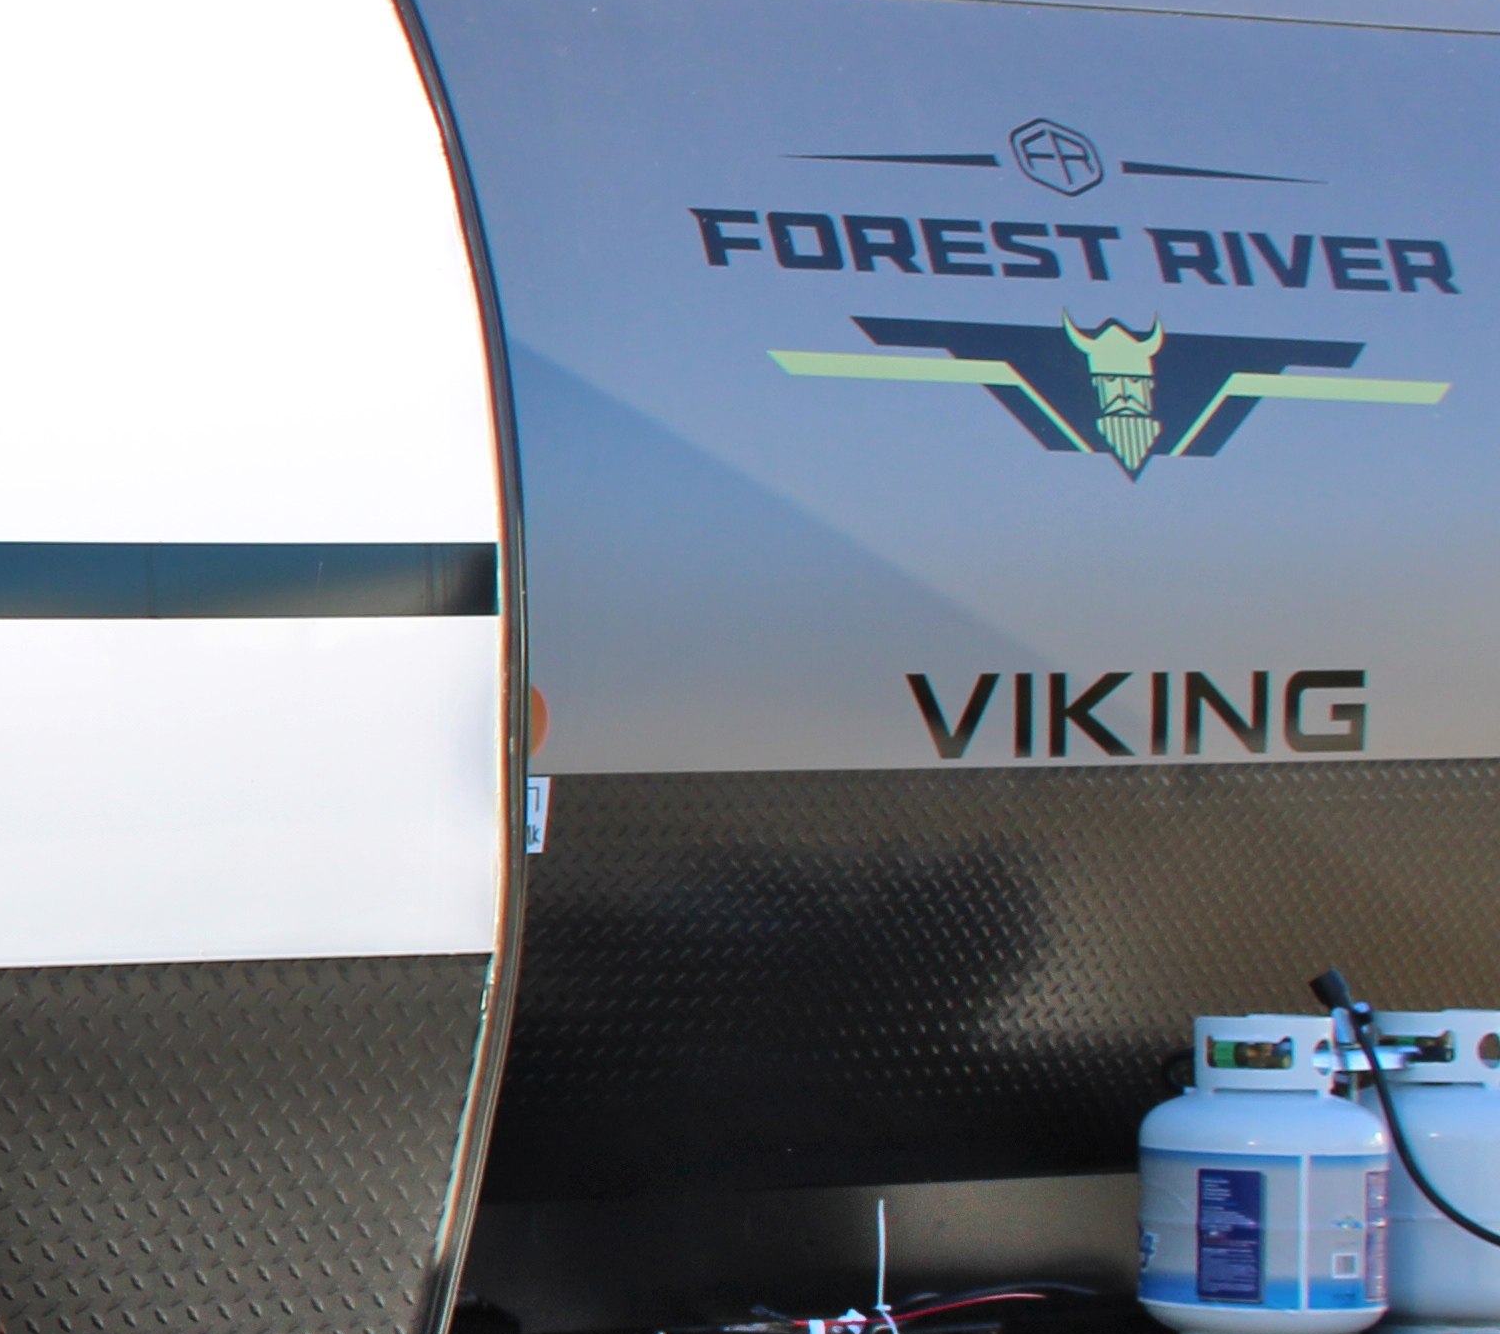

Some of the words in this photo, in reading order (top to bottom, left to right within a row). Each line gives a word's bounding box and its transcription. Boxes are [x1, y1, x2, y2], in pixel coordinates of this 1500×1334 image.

[688, 208, 1122, 282] FOREST
[1144, 227, 1461, 296] RIVER
[905, 669, 1367, 760] VIKING
